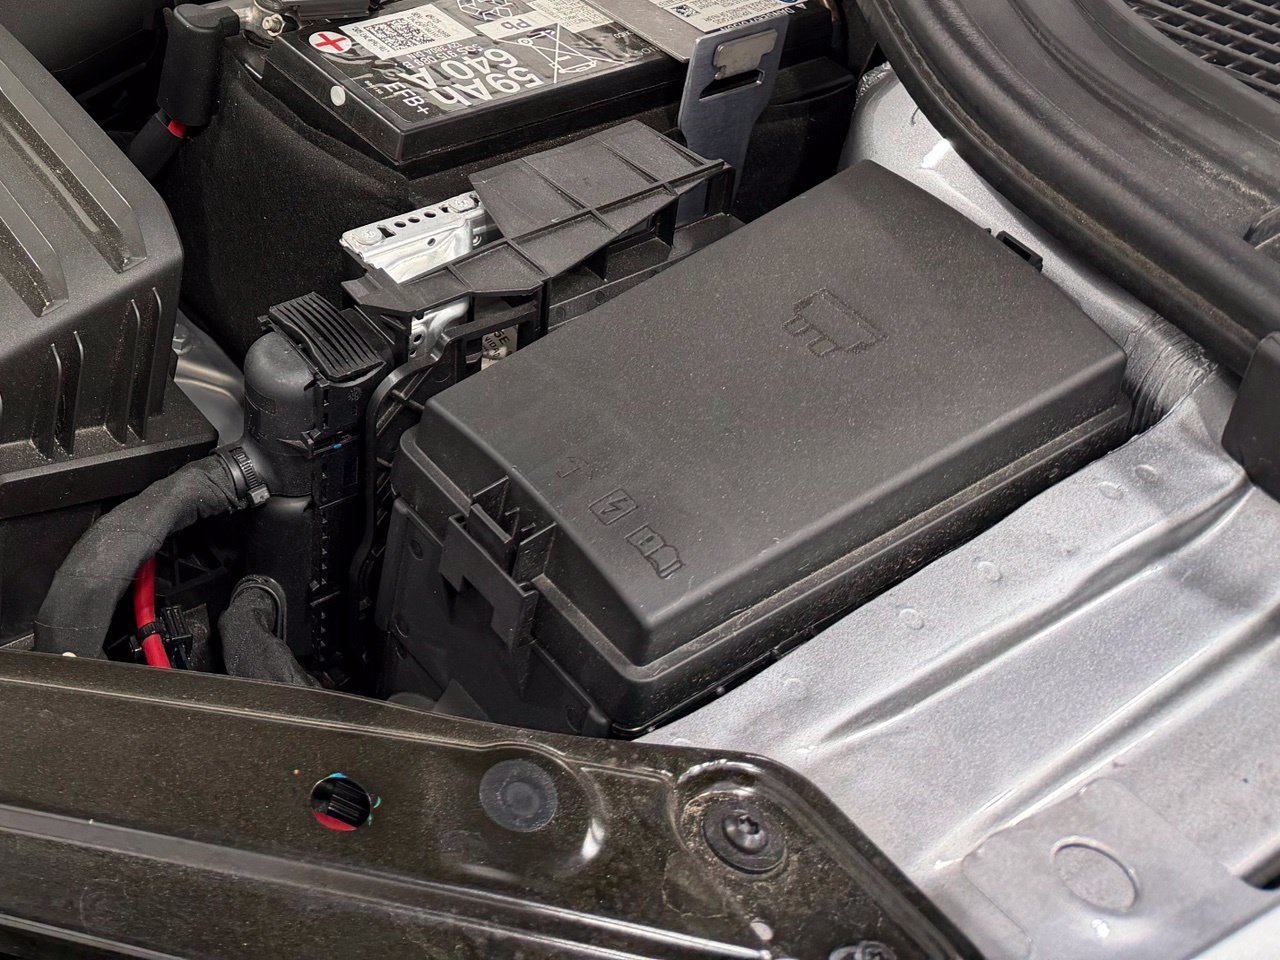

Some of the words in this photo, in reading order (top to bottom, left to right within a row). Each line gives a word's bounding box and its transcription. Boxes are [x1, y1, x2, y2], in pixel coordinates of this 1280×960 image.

[501, 18, 532, 30] Pb
[438, 50, 458, 61] 915
[441, 48, 518, 80] 640
[398, 68, 438, 90] A
[429, 67, 544, 106] 59Ah
[384, 81, 430, 115] EFB+
